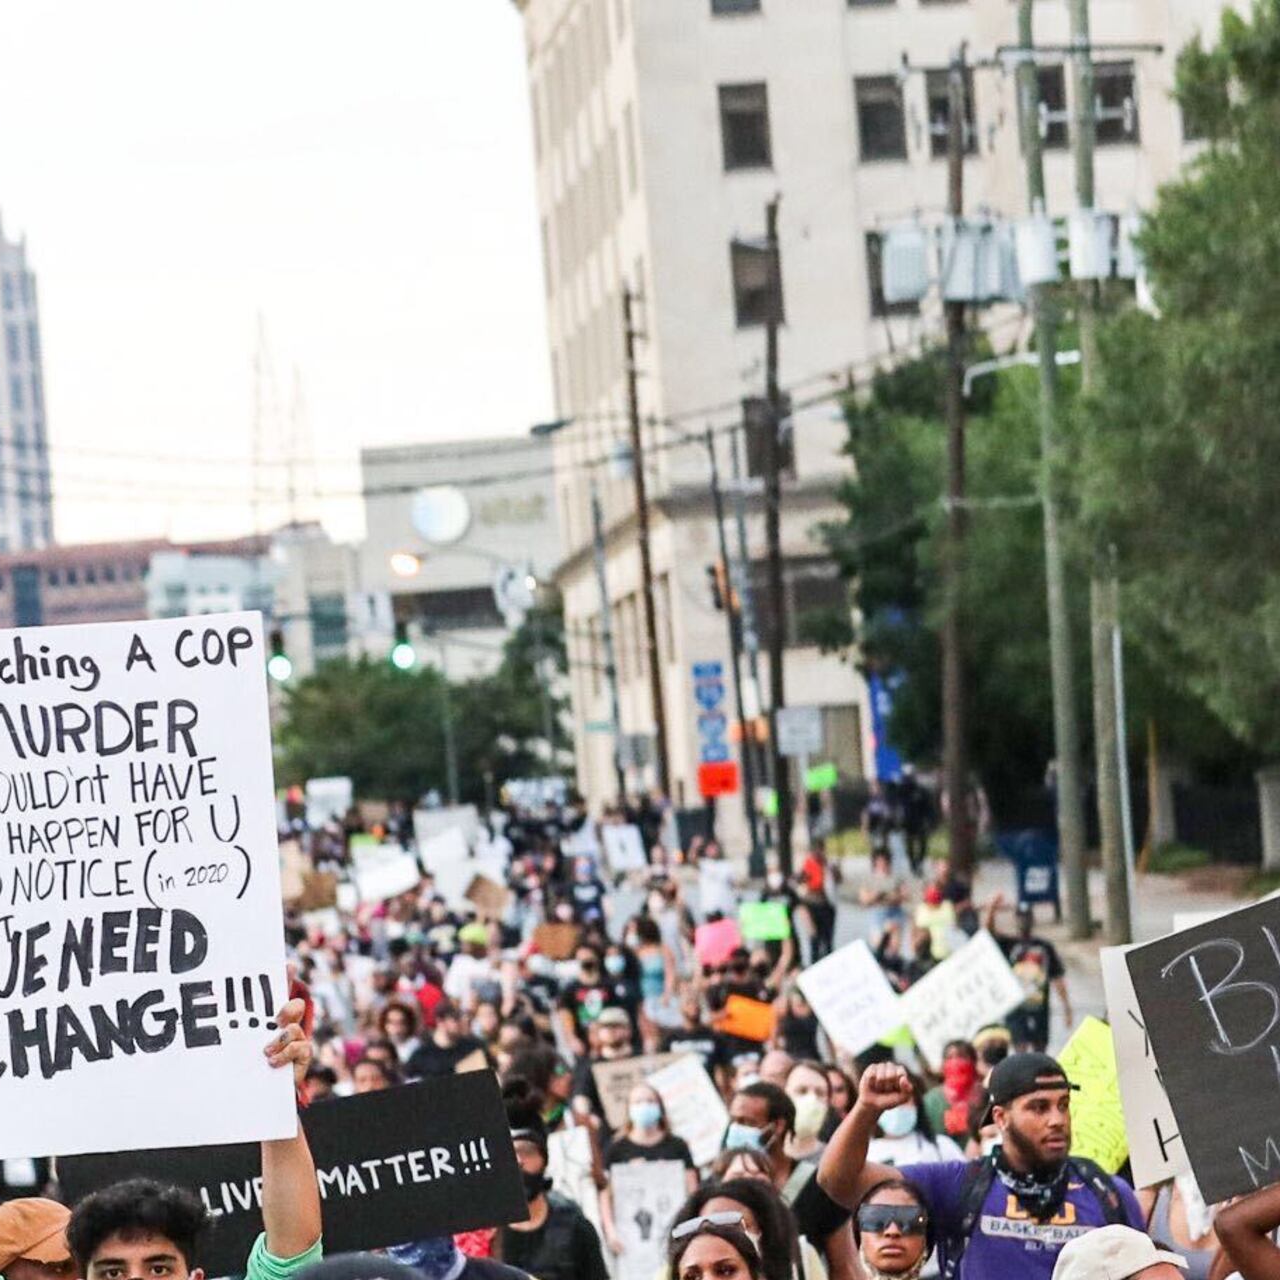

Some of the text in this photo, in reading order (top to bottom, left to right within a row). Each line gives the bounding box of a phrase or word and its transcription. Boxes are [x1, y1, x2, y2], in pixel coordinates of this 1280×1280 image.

[125, 633, 156, 673] A
[175, 626, 254, 669] COP
[129, 757, 218, 801] HAVE
[7, 814, 121, 855] HAPPEN
[135, 806, 194, 847] FOR
[210, 795, 241, 843] U
[11, 856, 135, 905] NOTICE
[57, 906, 209, 992] NEED
[316, 1137, 492, 1200] MATTER!!!
